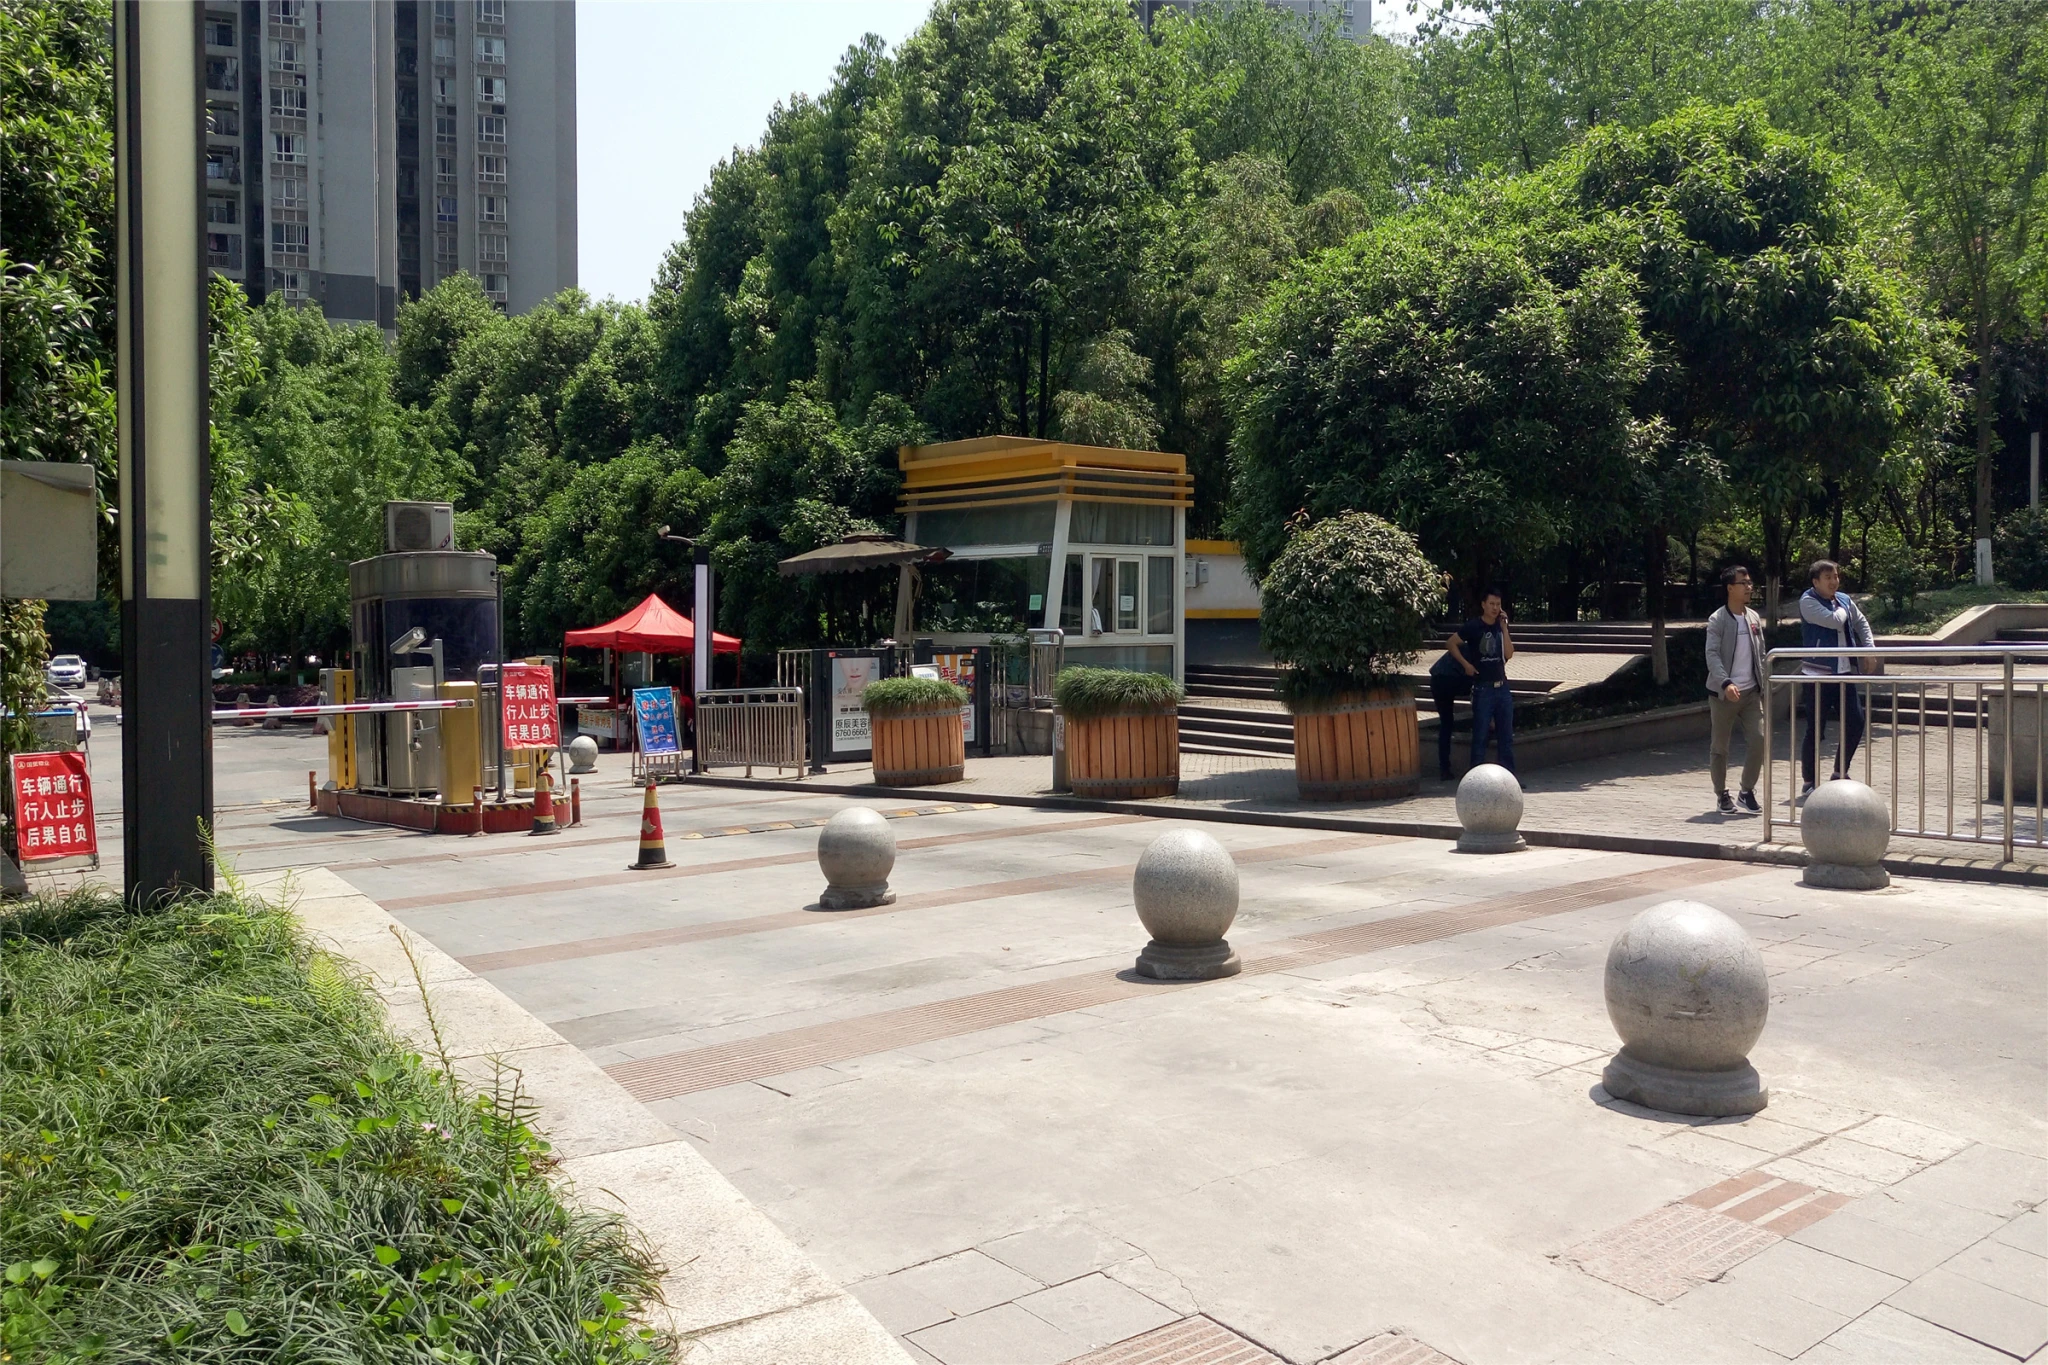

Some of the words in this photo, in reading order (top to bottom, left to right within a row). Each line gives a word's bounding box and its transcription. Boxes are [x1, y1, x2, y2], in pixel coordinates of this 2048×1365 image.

[505, 684, 549, 700] 车辆通行
[506, 703, 550, 720] 行人止步
[508, 723, 552, 740] 后果自负
[835, 729, 851, 738] 6760
[21, 774, 82, 797] 车辆通行
[24, 798, 85, 821] 行人止步
[27, 823, 87, 847] 后果自负
